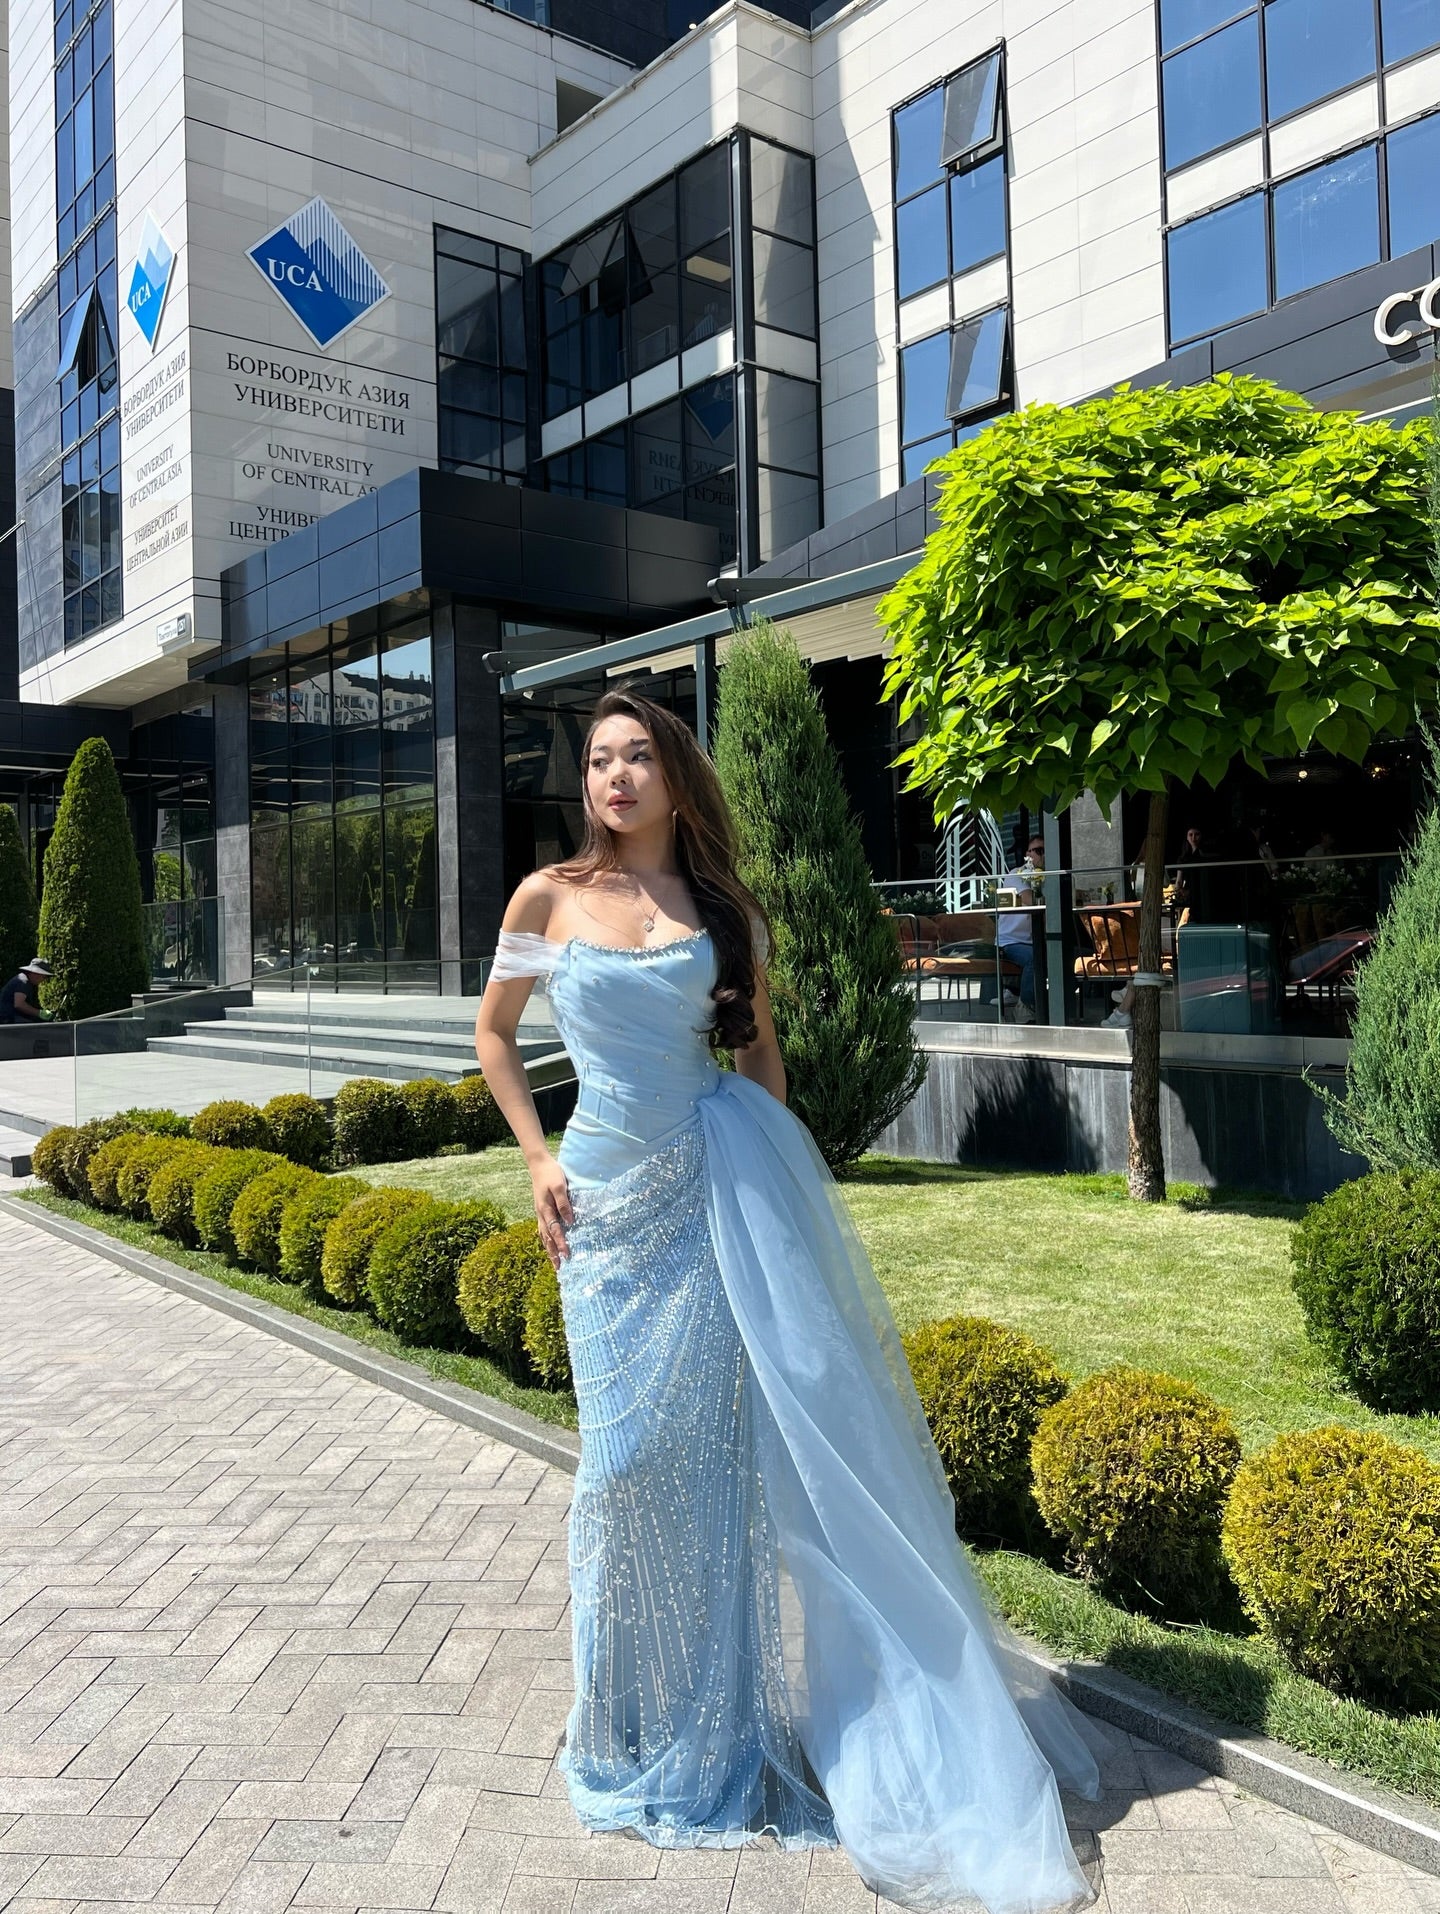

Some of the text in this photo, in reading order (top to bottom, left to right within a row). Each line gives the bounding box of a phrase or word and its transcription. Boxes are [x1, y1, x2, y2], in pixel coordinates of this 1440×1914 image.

[266, 257, 323, 293] UCA
[131, 281, 152, 313] UCA
[123, 349, 186, 418] БОРБОРДУК АЗИЯ
[226, 352, 411, 410] БОРБОРДУК АЗИЯ
[125, 378, 185, 441] УНИВЕРСИТЕТИ
[233, 383, 406, 436] УНИВЕРСИТЕТИ
[136, 443, 174, 483] UNIVERSITY
[242, 463, 267, 480] OF
[271, 468, 354, 497] CENTRAL
[266, 443, 374, 477] UNIVERSITY
[129, 461, 183, 509] OF CENTRAL ASIA
[133, 504, 179, 545] УНИВЕРСИТЕТ
[228, 520, 296, 543] ЦЕНТР
[126, 520, 189, 572] ЦЕНТРАЛЬНОЙ АЗИИ
